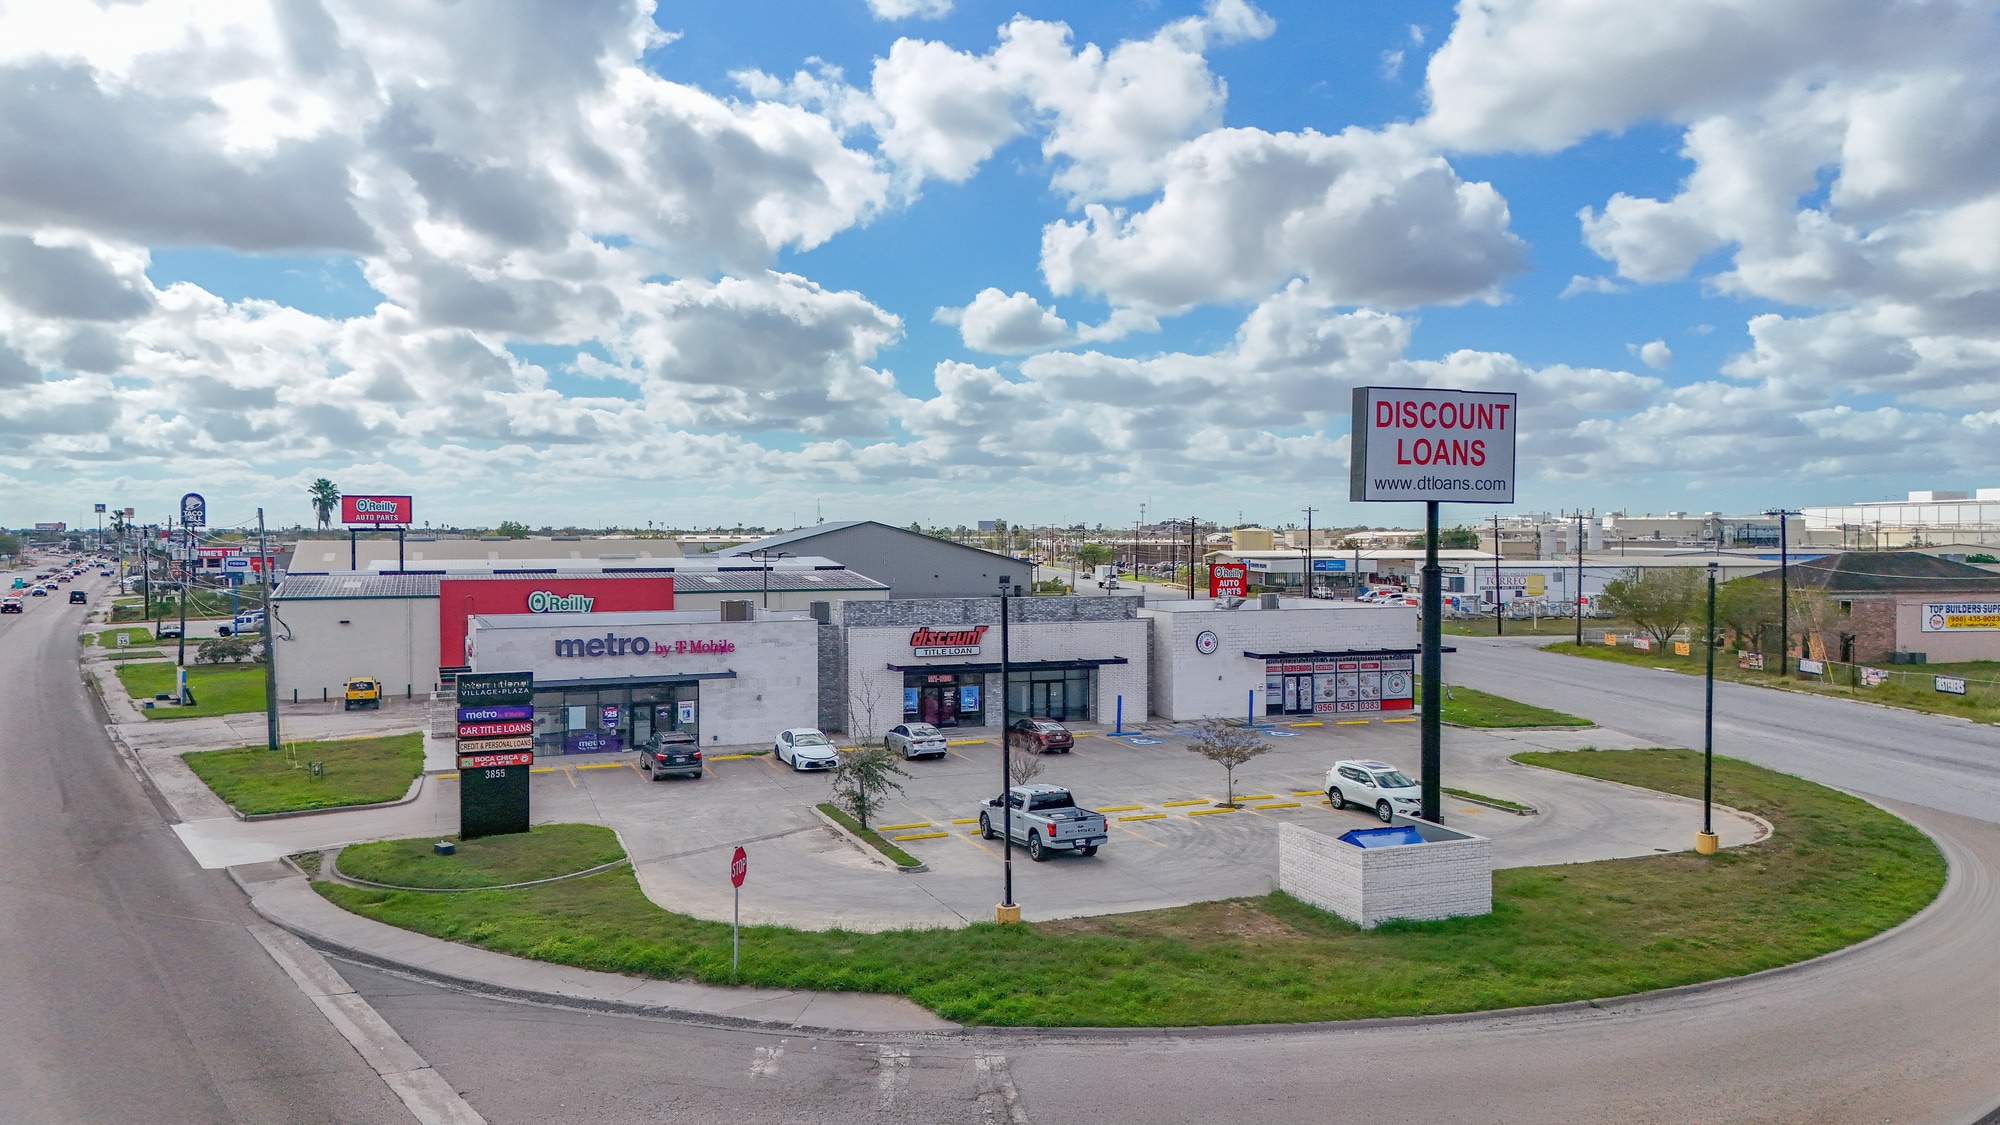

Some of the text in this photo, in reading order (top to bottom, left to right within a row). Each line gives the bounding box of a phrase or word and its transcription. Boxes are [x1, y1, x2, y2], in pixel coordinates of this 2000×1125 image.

[1376, 400, 1510, 430] DISCOUNT
[1397, 438, 1486, 467] LOANS
[1374, 475, 1506, 491] www.dtloans.com
[357, 498, 397, 513] O'Reilly
[1214, 566, 1244, 579] O'Reilly
[1219, 579, 1240, 587] AUTO
[1486, 577, 1526, 585] TORREO
[529, 591, 594, 613] O'Reilly
[1930, 605, 1943, 613] TOP
[1946, 605, 1981, 613] BUILDERS
[555, 633, 650, 657] metro
[654, 641, 671, 658] by
[1315, 701, 1380, 712] (956) 545 0383
[465, 710, 498, 720] metro
[460, 724, 532, 735] CAR TITLE LOANS
[460, 742, 480, 751] CREDIT
[485, 740, 513, 749] PERSONAL
[514, 739, 532, 747] LOANS
[485, 769, 506, 779] 3855
[732, 857, 746, 878] STOP
